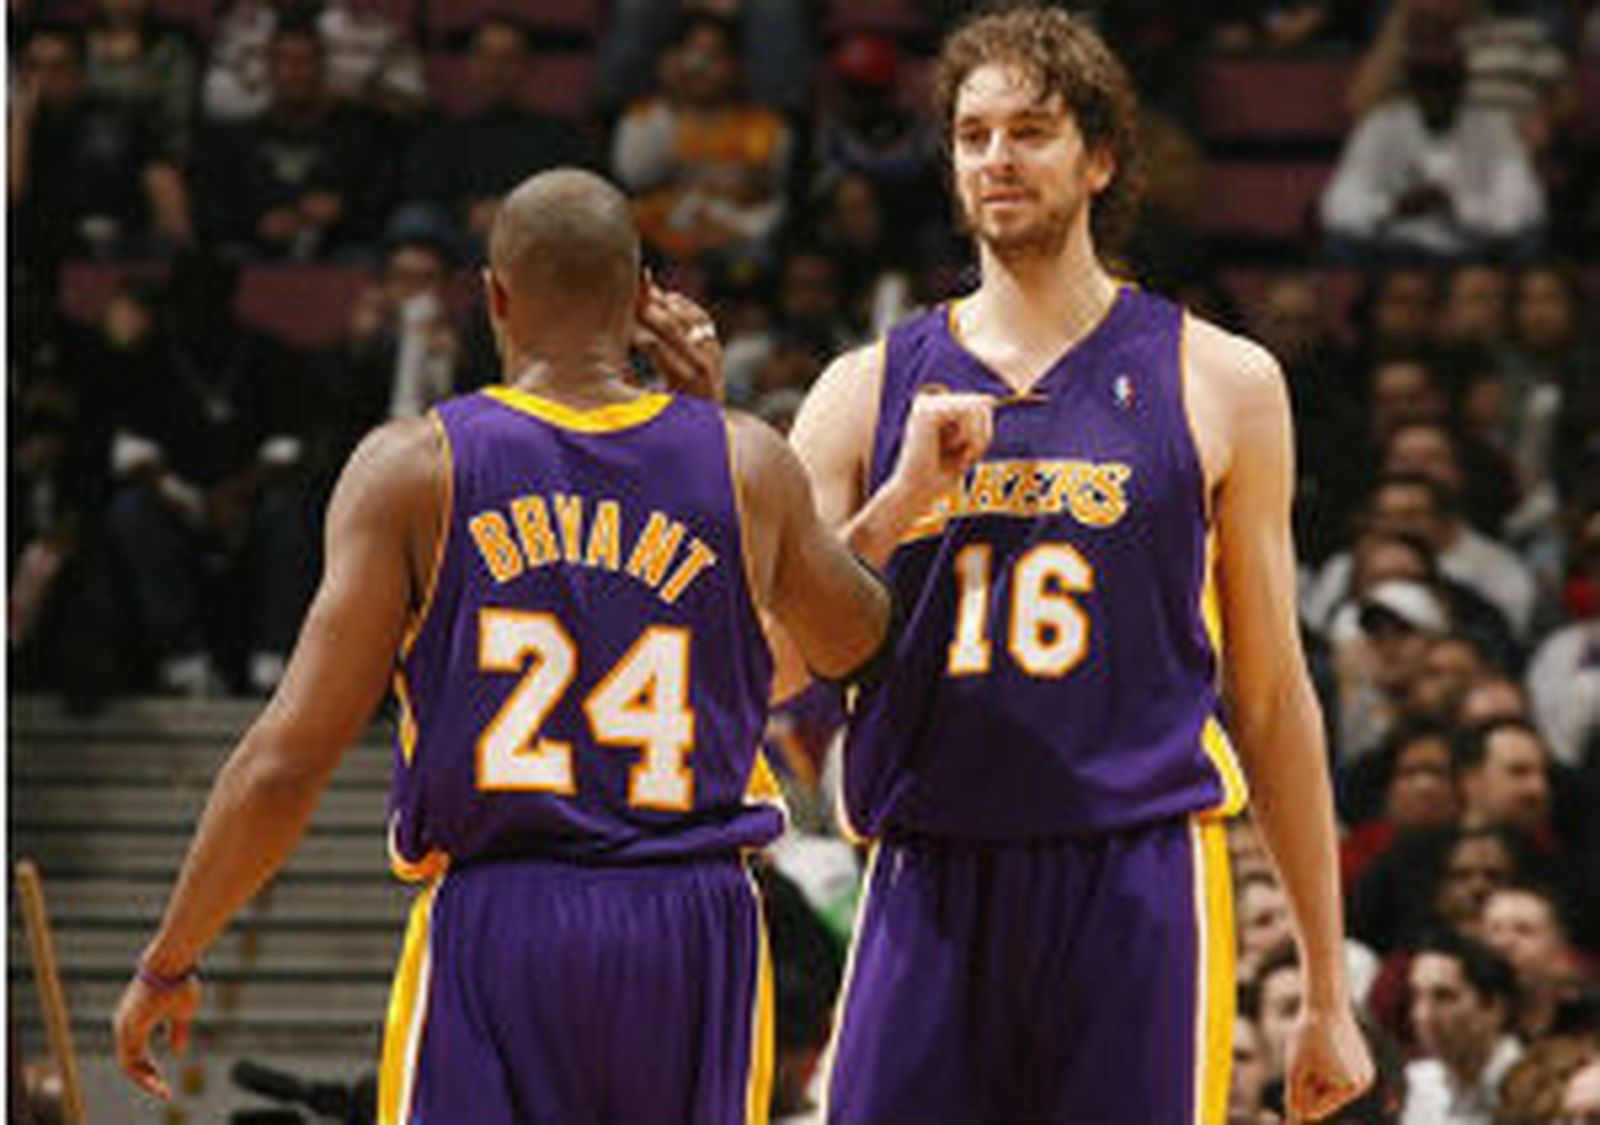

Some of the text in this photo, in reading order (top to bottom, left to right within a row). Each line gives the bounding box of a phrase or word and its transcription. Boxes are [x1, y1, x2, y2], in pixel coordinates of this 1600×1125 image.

[468, 493, 717, 604] BRYANT
[899, 458, 1132, 543] KERS
[946, 541, 1094, 678] 16
[475, 606, 696, 812] 24
